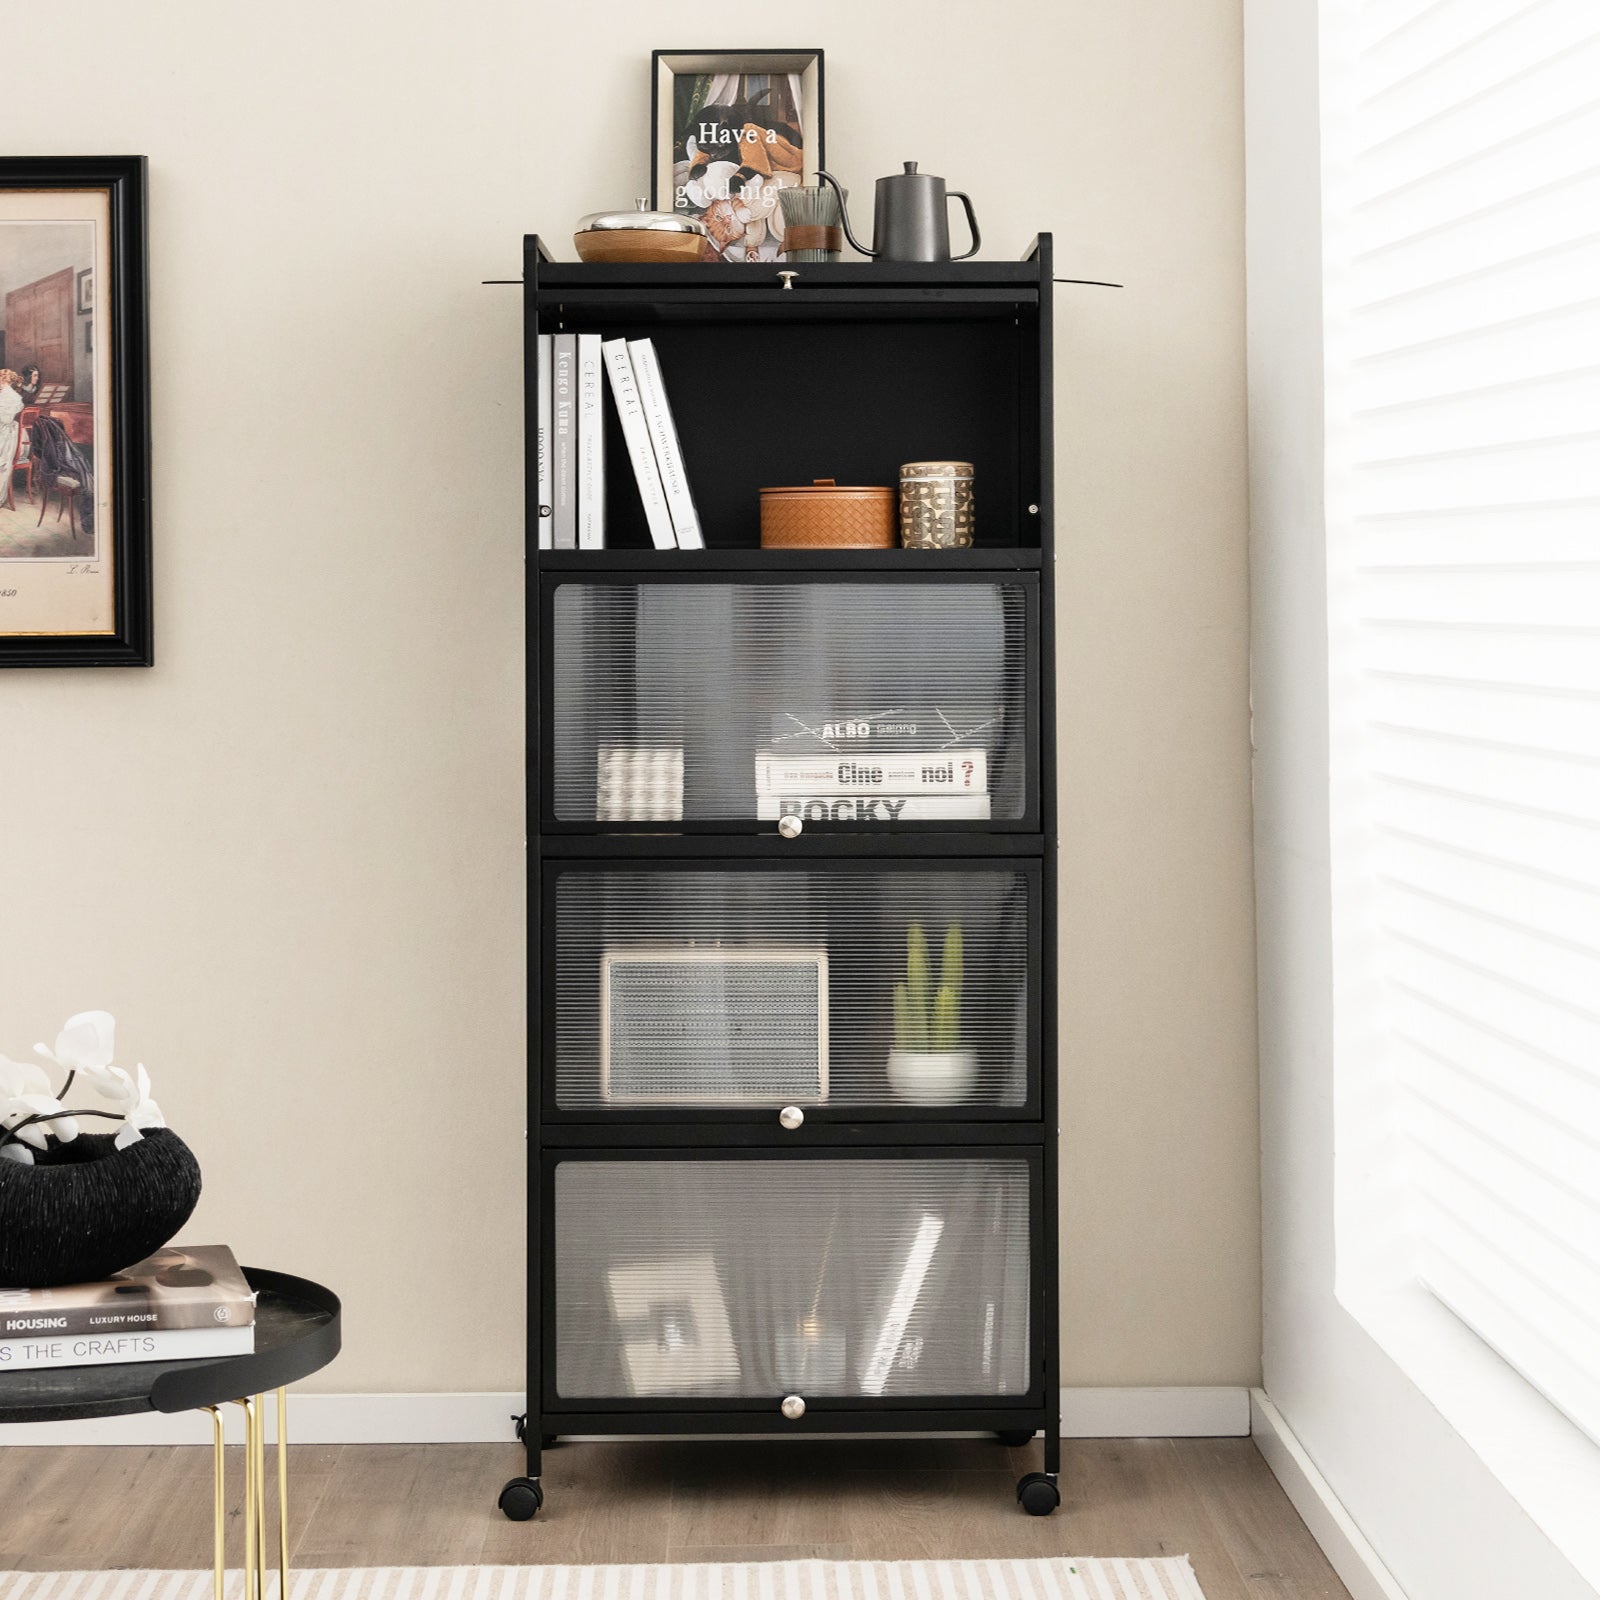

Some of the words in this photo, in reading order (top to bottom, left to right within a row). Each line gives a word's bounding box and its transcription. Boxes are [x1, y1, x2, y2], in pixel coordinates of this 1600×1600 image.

[698, 122, 759, 144] Have
[765, 129, 777, 144] a
[675, 178, 731, 208] good
[739, 178, 798, 208] nig
[558, 351, 572, 395] Kengo
[615, 354, 638, 416] CEREAL
[584, 360, 595, 418] CEREAL
[558, 400, 572, 435] Kuma
[838, 763, 883, 785] Cine
[961, 761, 974, 787] ?
[6, 1317, 68, 1331] HOUSING
[90, 1316, 125, 1325] LUXURY
[127, 1313, 158, 1322] HOUSE
[22, 1343, 62, 1360] THE
[73, 1337, 155, 1357] CRAFTS
